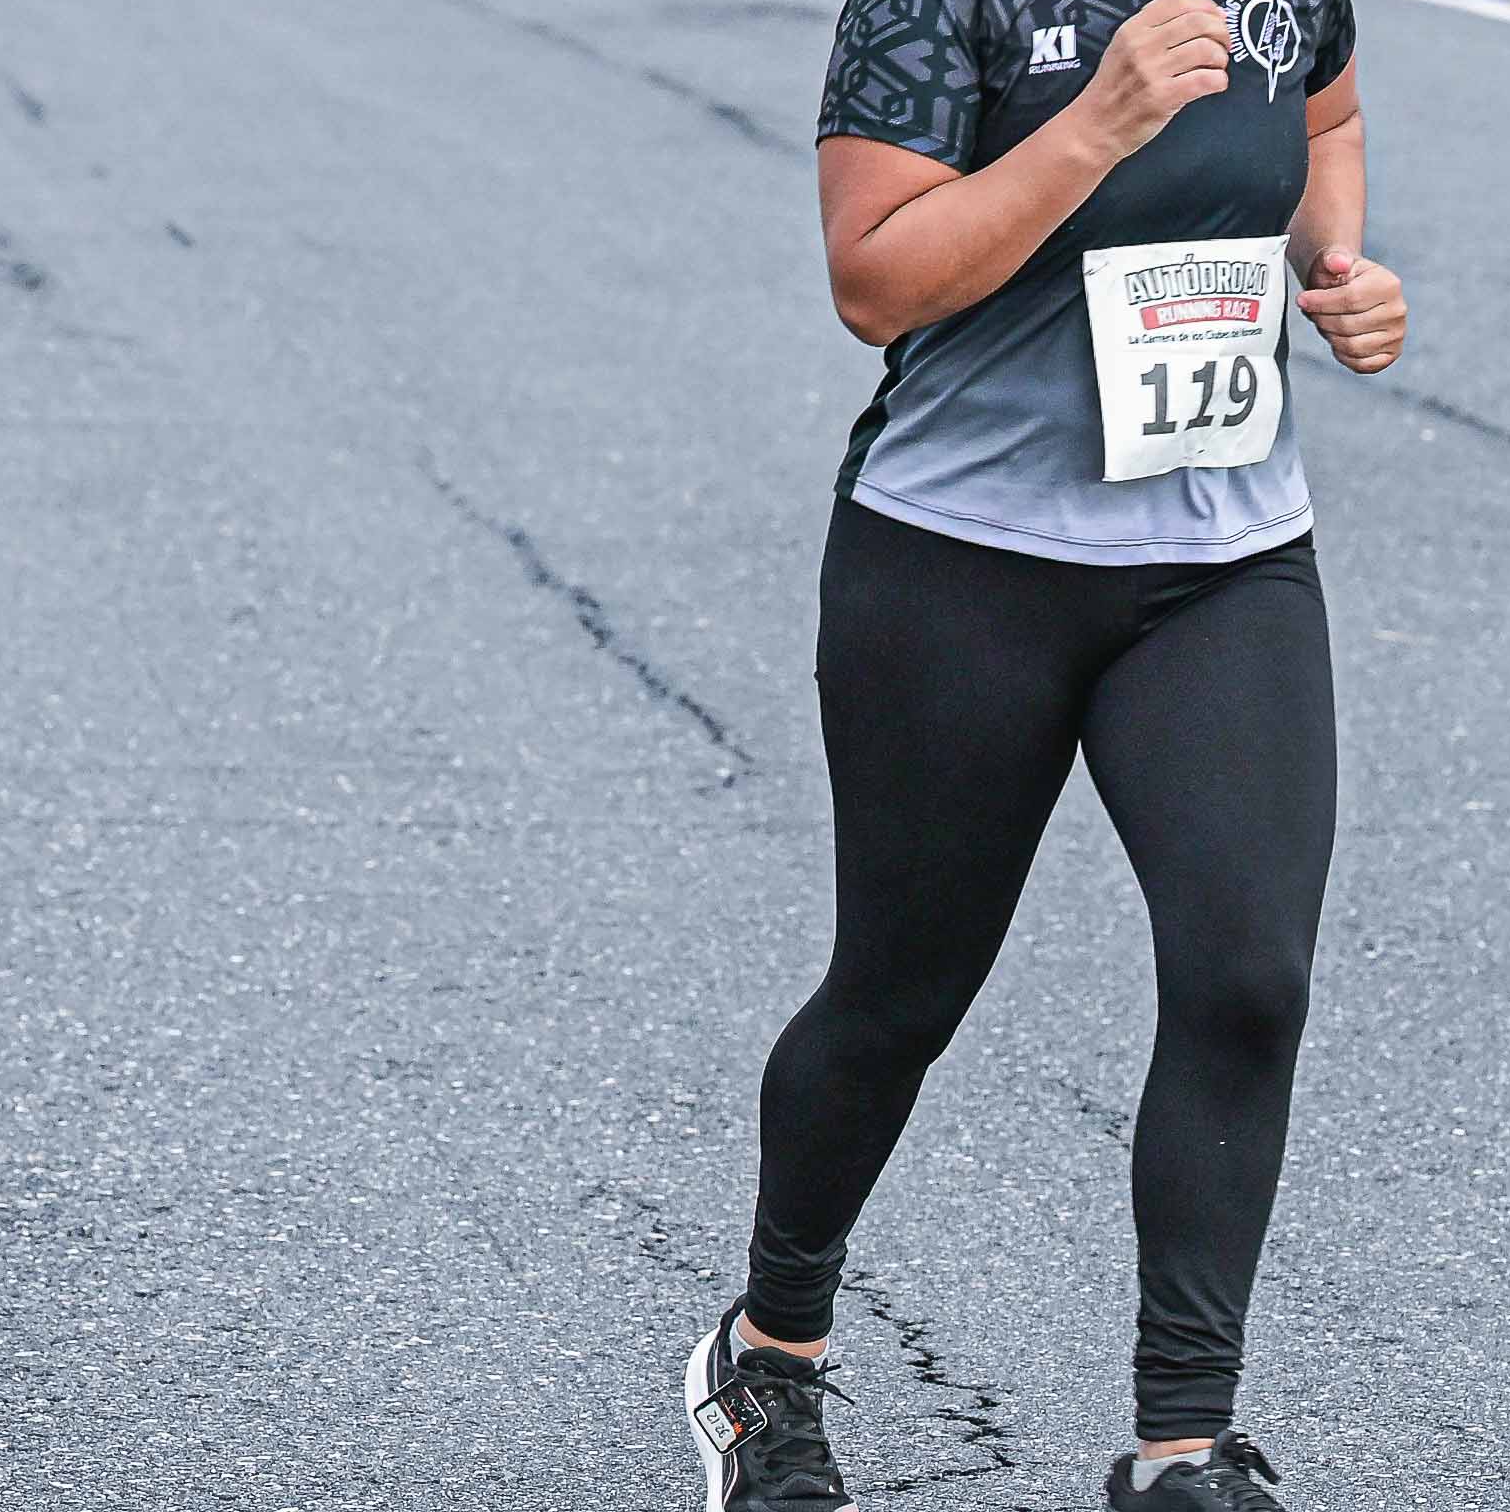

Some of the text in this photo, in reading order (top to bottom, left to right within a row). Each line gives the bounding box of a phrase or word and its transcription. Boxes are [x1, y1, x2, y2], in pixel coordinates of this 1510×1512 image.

[1030, 24, 1077, 65] K1
[1125, 253, 1268, 305] AUTÓDROMO
[1156, 300, 1222, 325] RUNNING
[1140, 355, 1258, 436] 119
